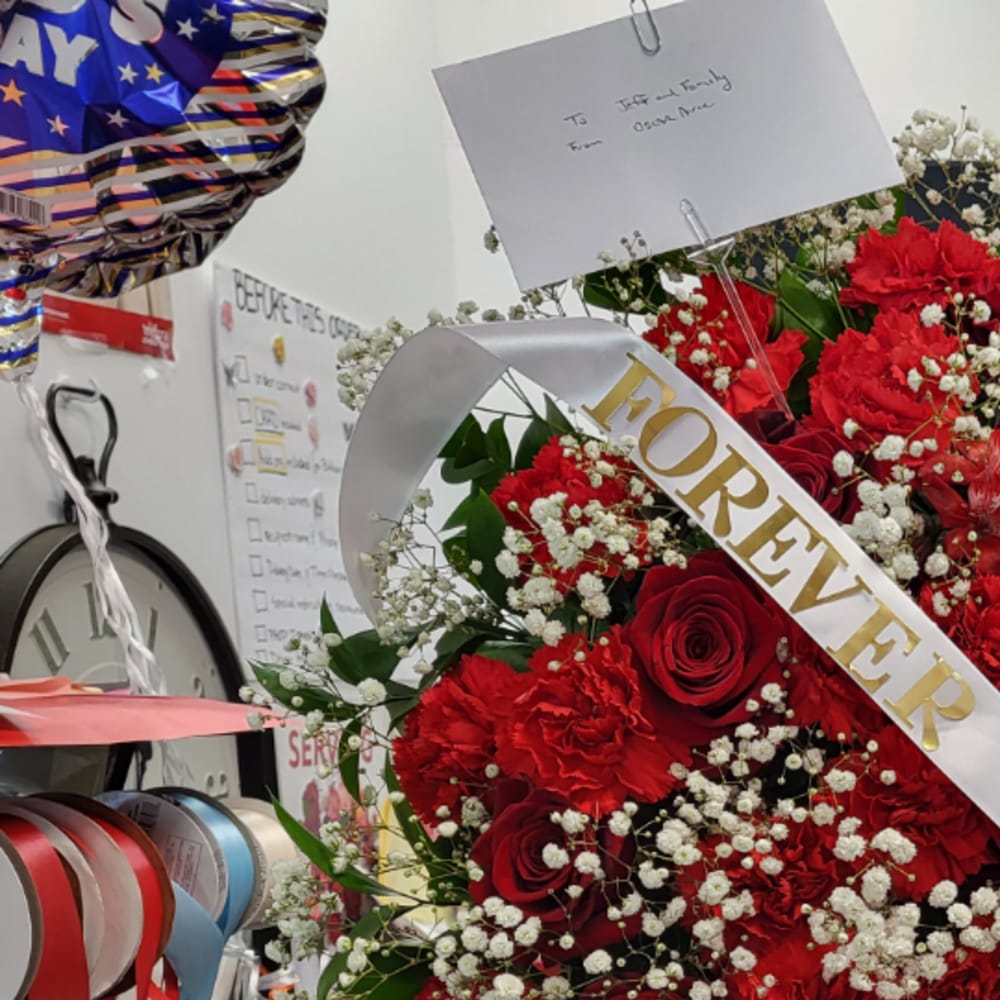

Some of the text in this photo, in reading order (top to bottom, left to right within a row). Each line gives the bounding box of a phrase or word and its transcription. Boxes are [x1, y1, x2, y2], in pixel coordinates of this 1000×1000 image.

[563, 112, 588, 126] To
[680, 68, 733, 92] Family
[567, 140, 602, 151] From
[232, 268, 292, 324] BEFORE
[581, 352, 976, 752] FOREVER
